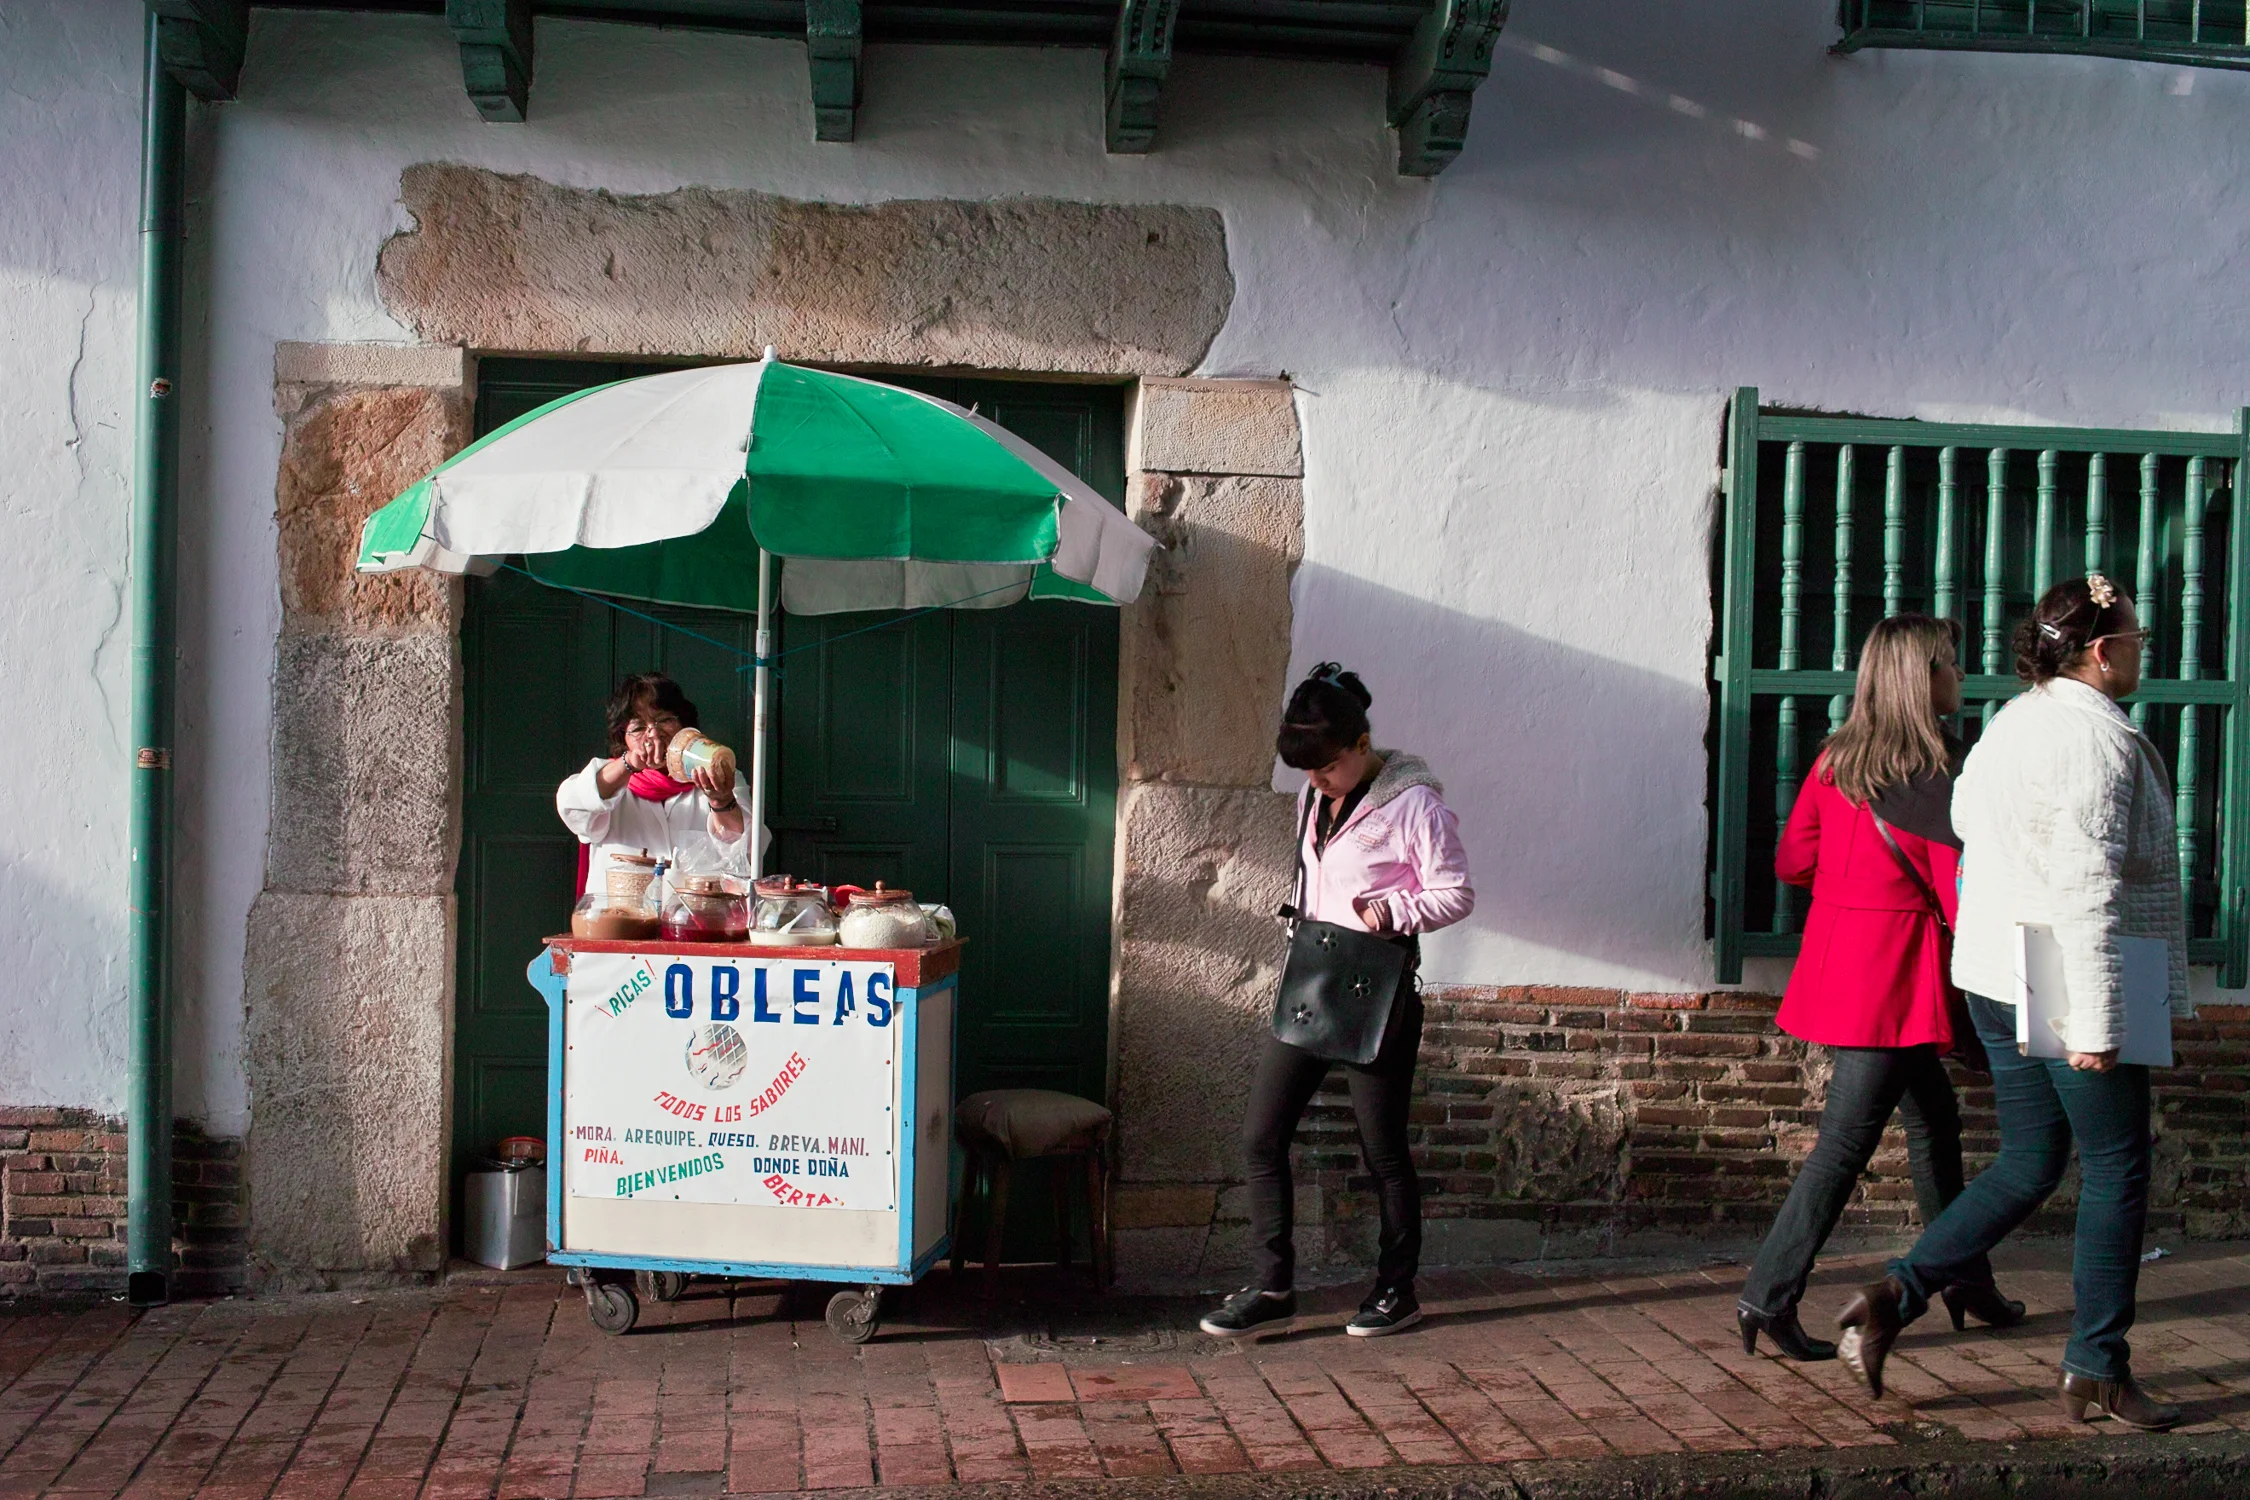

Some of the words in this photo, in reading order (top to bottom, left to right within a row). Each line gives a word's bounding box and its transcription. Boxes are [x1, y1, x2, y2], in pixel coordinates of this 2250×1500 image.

[664, 963, 892, 1028] OBLEAS
[653, 1091, 707, 1122] TODOS
[714, 1105, 742, 1123] LOS
[576, 1126, 617, 1142] MORA.
[624, 1128, 703, 1148] AREQUIPE.
[708, 1132, 759, 1148] QUESO.
[768, 1134, 825, 1154] BREVA.
[828, 1136, 870, 1157] MANI.
[584, 1146, 624, 1166] PIÑA.
[616, 1152, 725, 1197] BIENVENIDOS
[753, 1157, 801, 1175] DONDE
[808, 1156, 850, 1178] DOÑA
